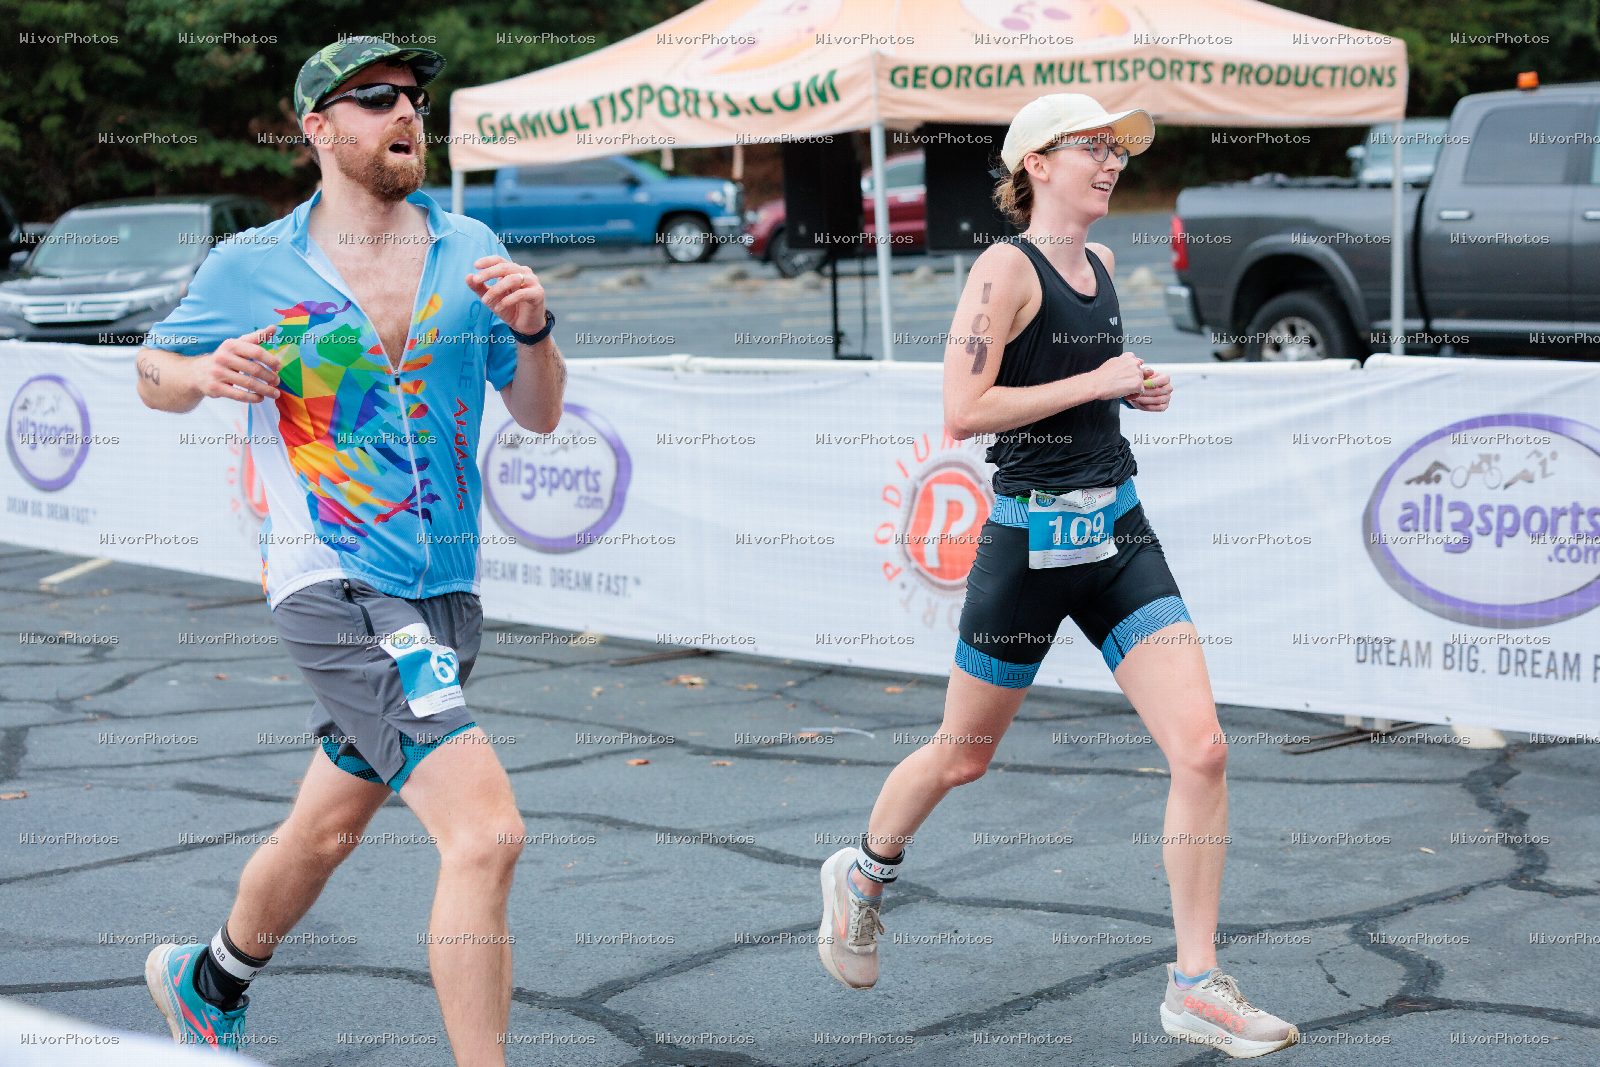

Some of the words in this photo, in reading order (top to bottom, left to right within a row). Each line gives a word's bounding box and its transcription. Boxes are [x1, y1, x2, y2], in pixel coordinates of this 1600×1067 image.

[890, 63, 1025, 89] GEORGIA
[1033, 58, 1215, 86] MULTISPORTS
[1221, 62, 1397, 88] PRODUCTIONS
[498, 457, 602, 500] all3sports
[574, 494, 605, 510] .com
[1048, 511, 1105, 546] 109
[1398, 493, 1600, 554] all3sports
[551, 568, 593, 593] DREAM
[1356, 638, 1433, 669] DREAM
[1443, 643, 1487, 674] BIG.
[1498, 648, 1582, 682] DREAM
